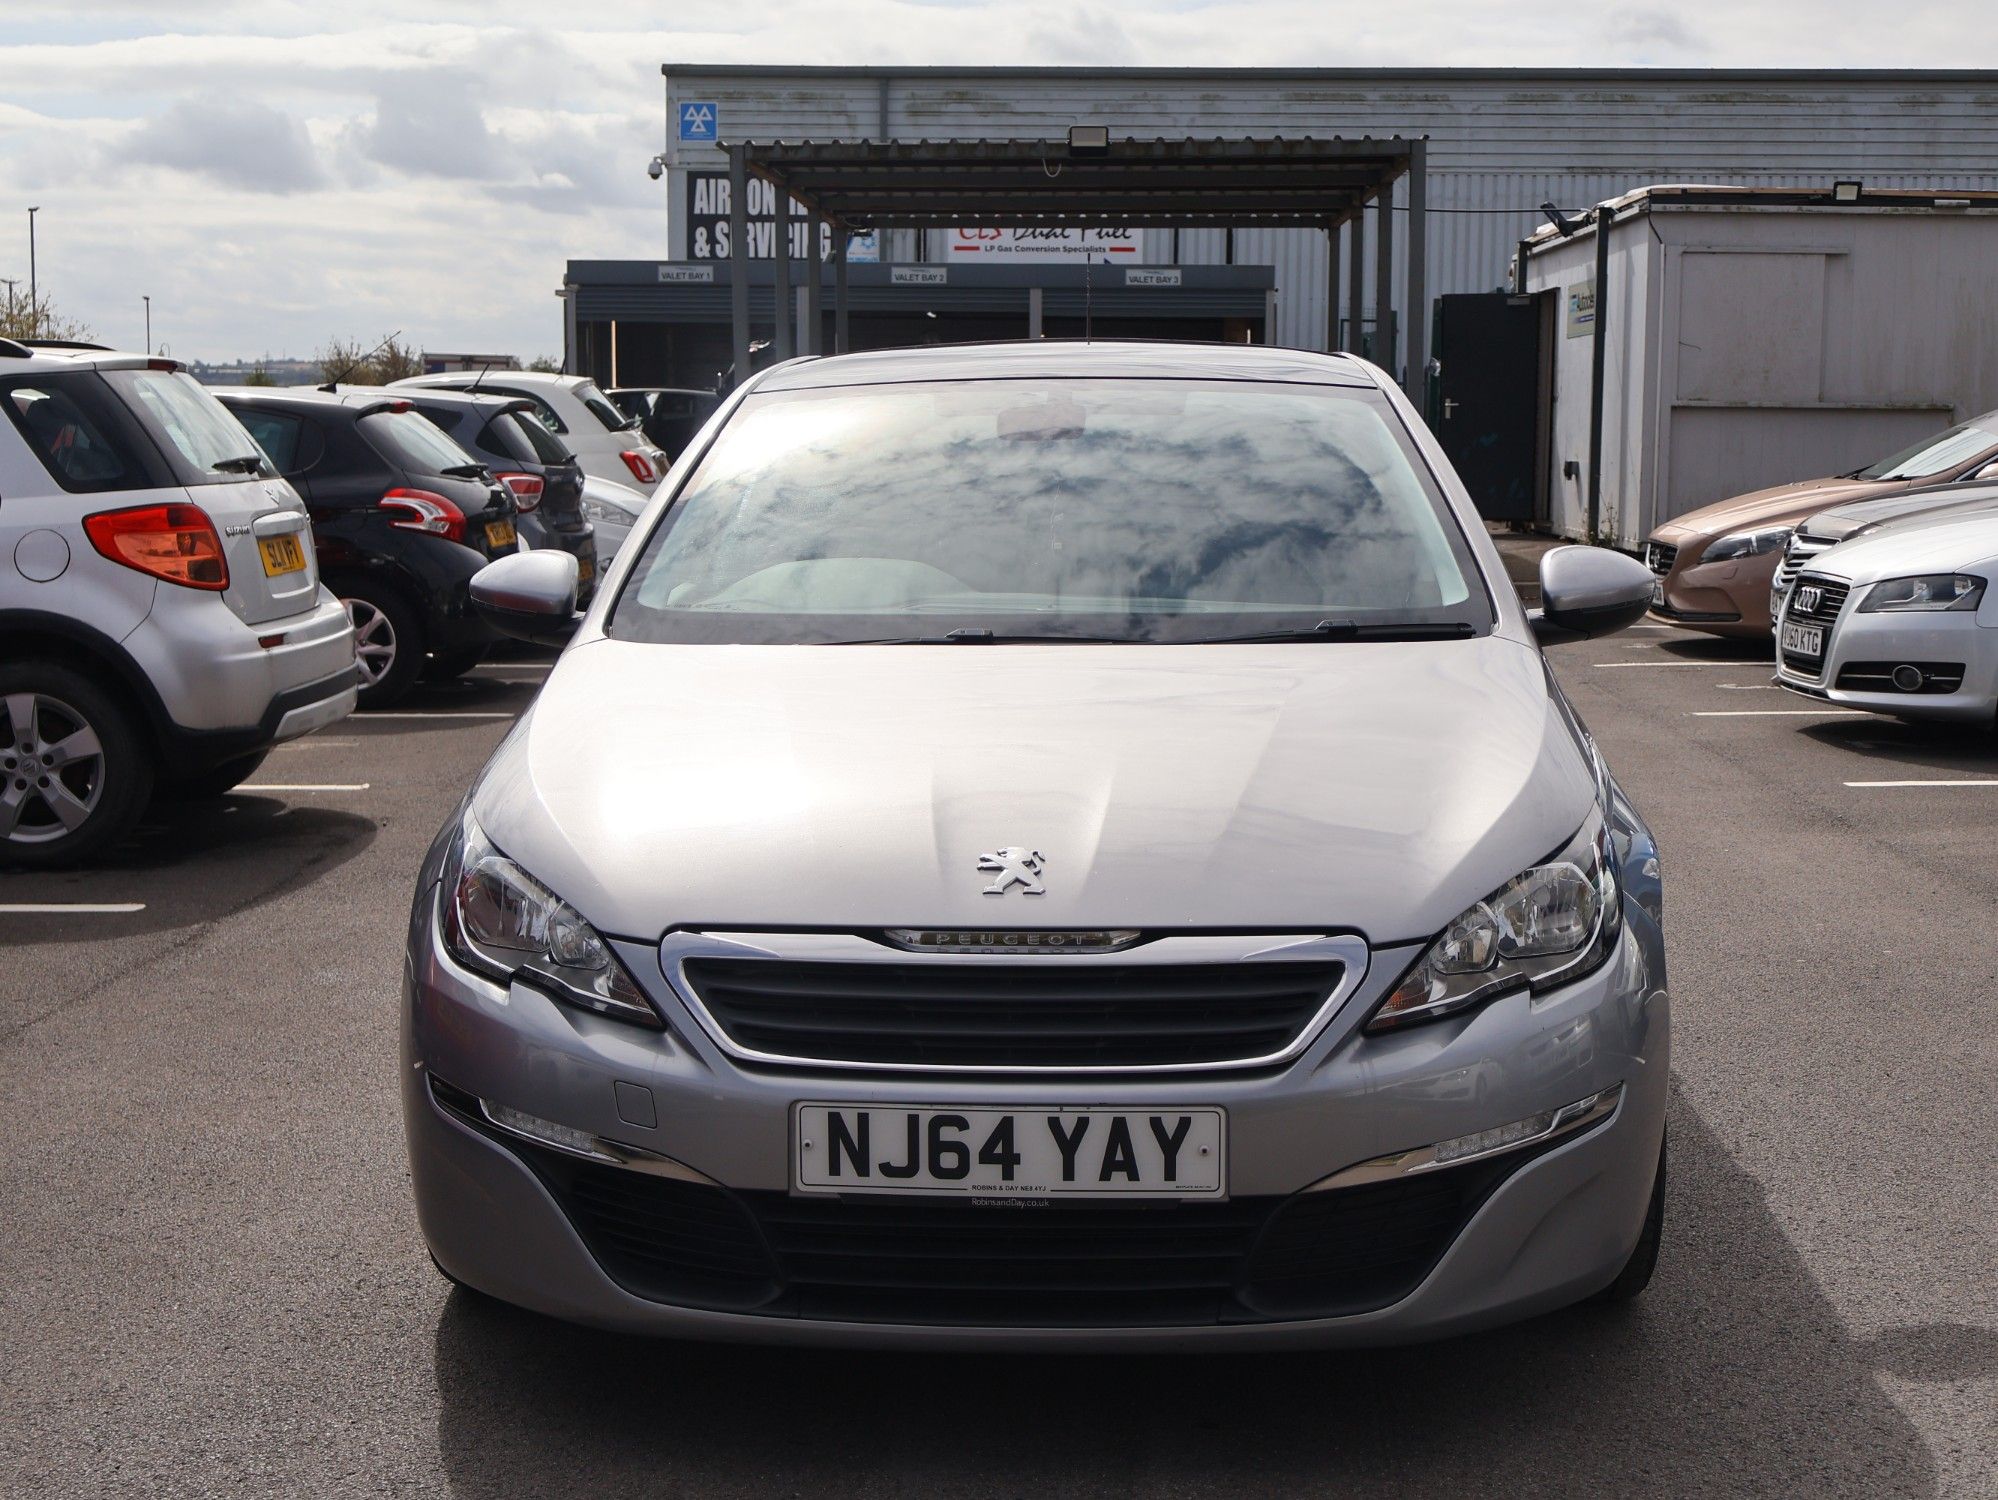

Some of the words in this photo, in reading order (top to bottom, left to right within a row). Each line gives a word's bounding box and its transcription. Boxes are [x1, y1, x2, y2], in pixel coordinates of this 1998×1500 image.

[694, 178, 732, 215] AIR
[747, 178, 776, 216] ON
[694, 226, 711, 258] &
[984, 245, 996, 253] LP
[997, 245, 1013, 253] Gas
[1014, 245, 1061, 253] Conversion
[1062, 245, 1107, 254] Specialists
[661, 271, 687, 280] VALET
[688, 271, 705, 280] BAY
[894, 272, 921, 282] VALET
[922, 273, 938, 282] BAY
[1128, 275, 1154, 284] VALET
[1155, 275, 1172, 284] BAY
[1800, 629, 1819, 653] KTG
[936, 933, 1086, 945] PEUGEOT
[827, 1111, 1021, 1181] NJ64
[1047, 1116, 1192, 1182] YAY
[971, 1198, 1050, 1208] RobinsandDay.co.uk
